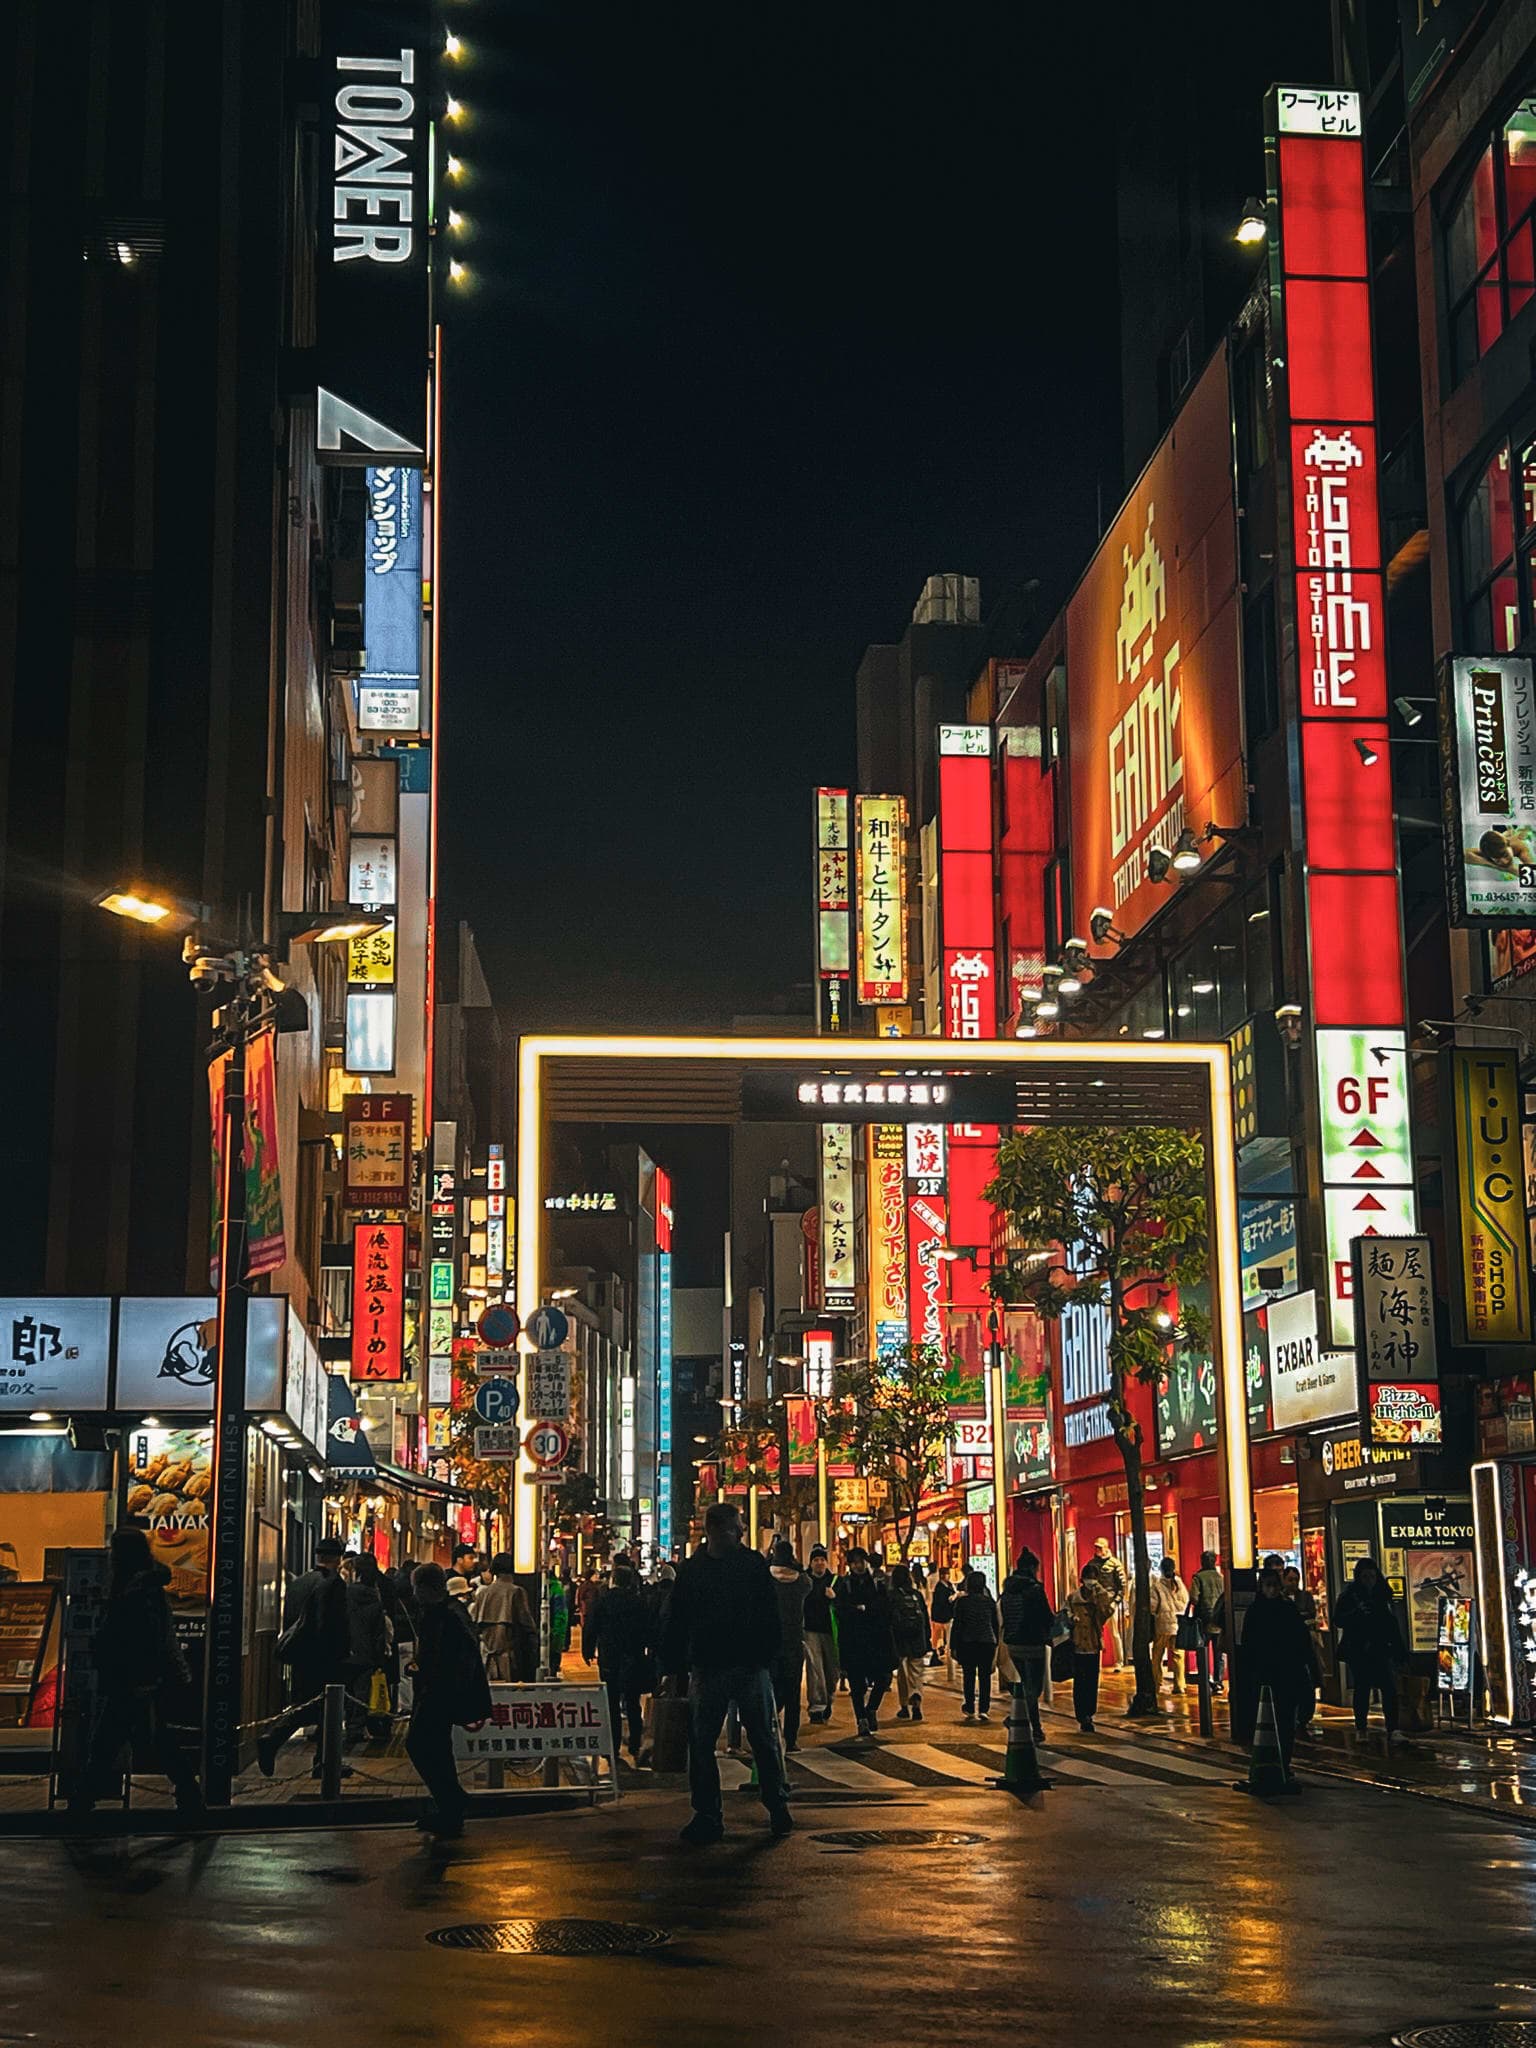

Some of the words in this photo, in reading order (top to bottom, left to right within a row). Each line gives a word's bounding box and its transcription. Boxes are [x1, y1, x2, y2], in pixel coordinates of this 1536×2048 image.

[1281, 93, 1349, 110] ワールド
[1322, 117, 1357, 132] ビル
[334, 49, 414, 261] TOWER
[1305, 475, 1321, 566] TAITO
[1321, 476, 1371, 707] GAME
[1309, 578, 1327, 706] STATION
[1514, 676, 1530, 756] リフレッシュ
[941, 728, 983, 740] ワールド
[966, 743, 988, 753] ビル
[1109, 640, 1184, 860] GAME
[1474, 686, 1499, 802] Princess
[1518, 765, 1535, 811] 新宿店
[358, 862, 374, 890] 味王
[822, 863, 833, 899] 牛タン
[1113, 847, 1141, 911] TAITO
[1521, 866, 1536, 887] 3
[363, 904, 382, 912] 3F
[874, 983, 892, 996] 5F
[888, 1010, 903, 1018] 4F
[1336, 1077, 1390, 1115] 6F
[915, 1129, 942, 1173] 浜焼
[566, 1193, 617, 1211] 中村屋
[917, 1179, 942, 1195] 2F
[832, 1219, 847, 1264] 大江戸
[1368, 1246, 1425, 1281] 麺屋
[1488, 1250, 1507, 1316] SHOP
[12, 1315, 63, 1366] 郎
[1379, 1285, 1420, 1374] 海神
[1277, 1337, 1314, 1376] EXBAR
[1371, 1329, 1382, 1370] らーめん
[486, 1390, 504, 1419] P
[497, 1405, 511, 1419] 40
[1375, 1405, 1435, 1421] Highball
[1380, 1388, 1418, 1404] Pizza
[535, 1434, 559, 1454] 30
[962, 1424, 993, 1444] B2
[1333, 1438, 1362, 1471] BEER
[220, 1424, 239, 1543] SHINJUKU
[1391, 1526, 1432, 1538] EXBAR
[1434, 1526, 1474, 1538] TOKYO
[215, 1558, 235, 1686] RAMBLING
[489, 1701, 602, 1730] 車両通行止
